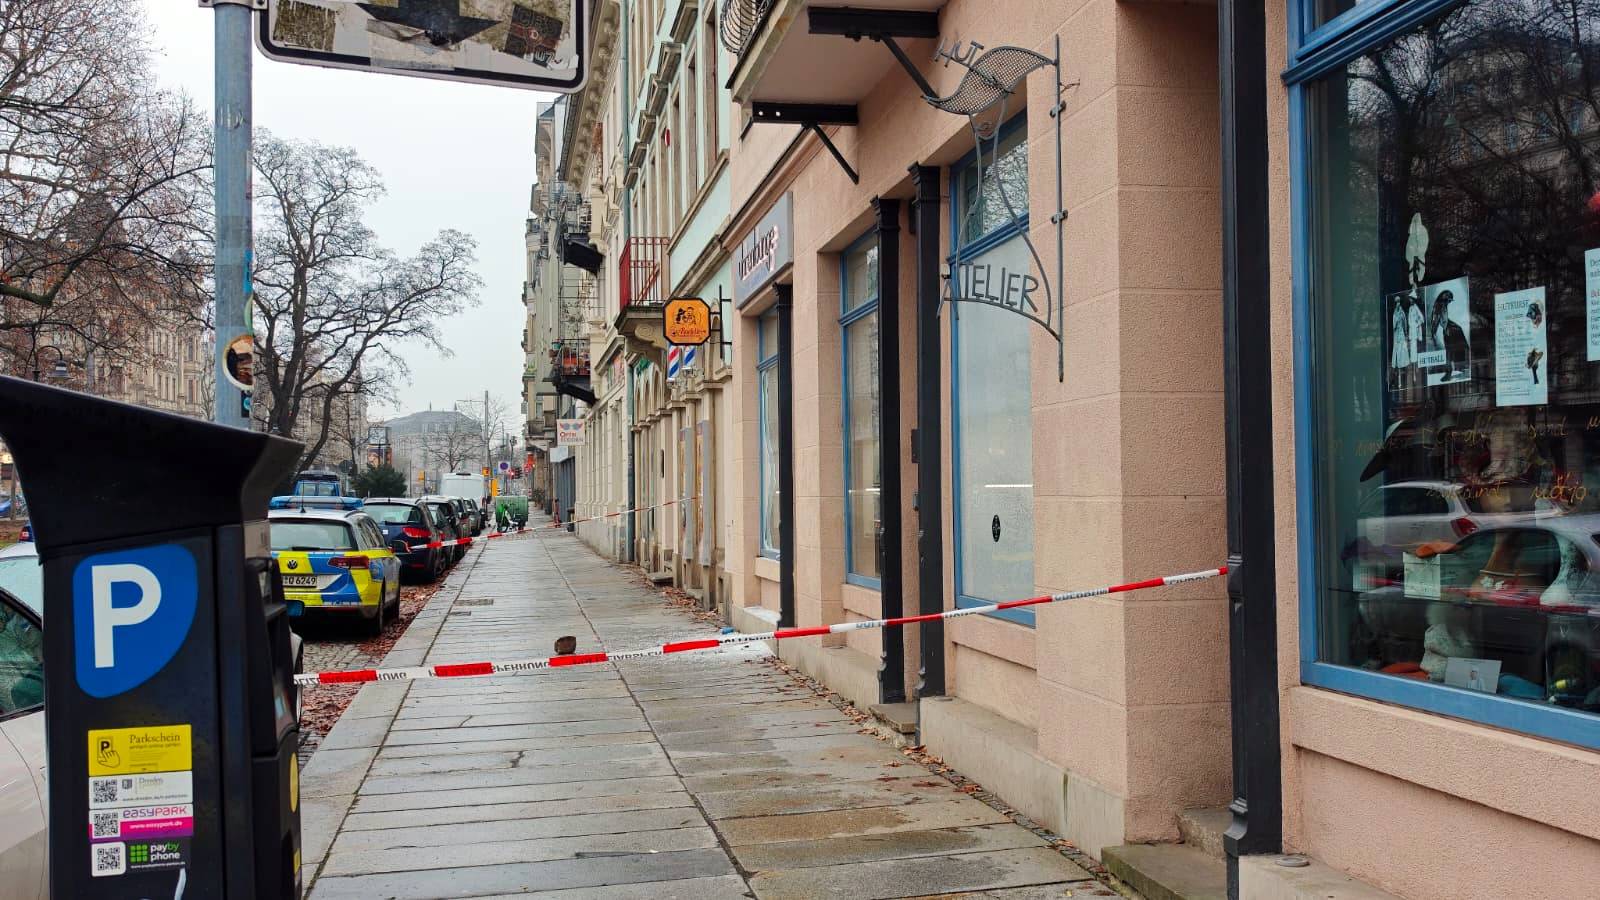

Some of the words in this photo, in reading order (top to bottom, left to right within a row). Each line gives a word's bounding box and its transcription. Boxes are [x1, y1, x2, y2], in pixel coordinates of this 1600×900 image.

[935, 36, 984, 68] HUT
[936, 260, 1039, 320] ATELIER
[296, 576, 316, 586] 6249
[91, 563, 162, 669] P
[129, 731, 181, 744] Parkschein
[101, 741, 110, 751] P
[150, 852, 181, 863] phone
